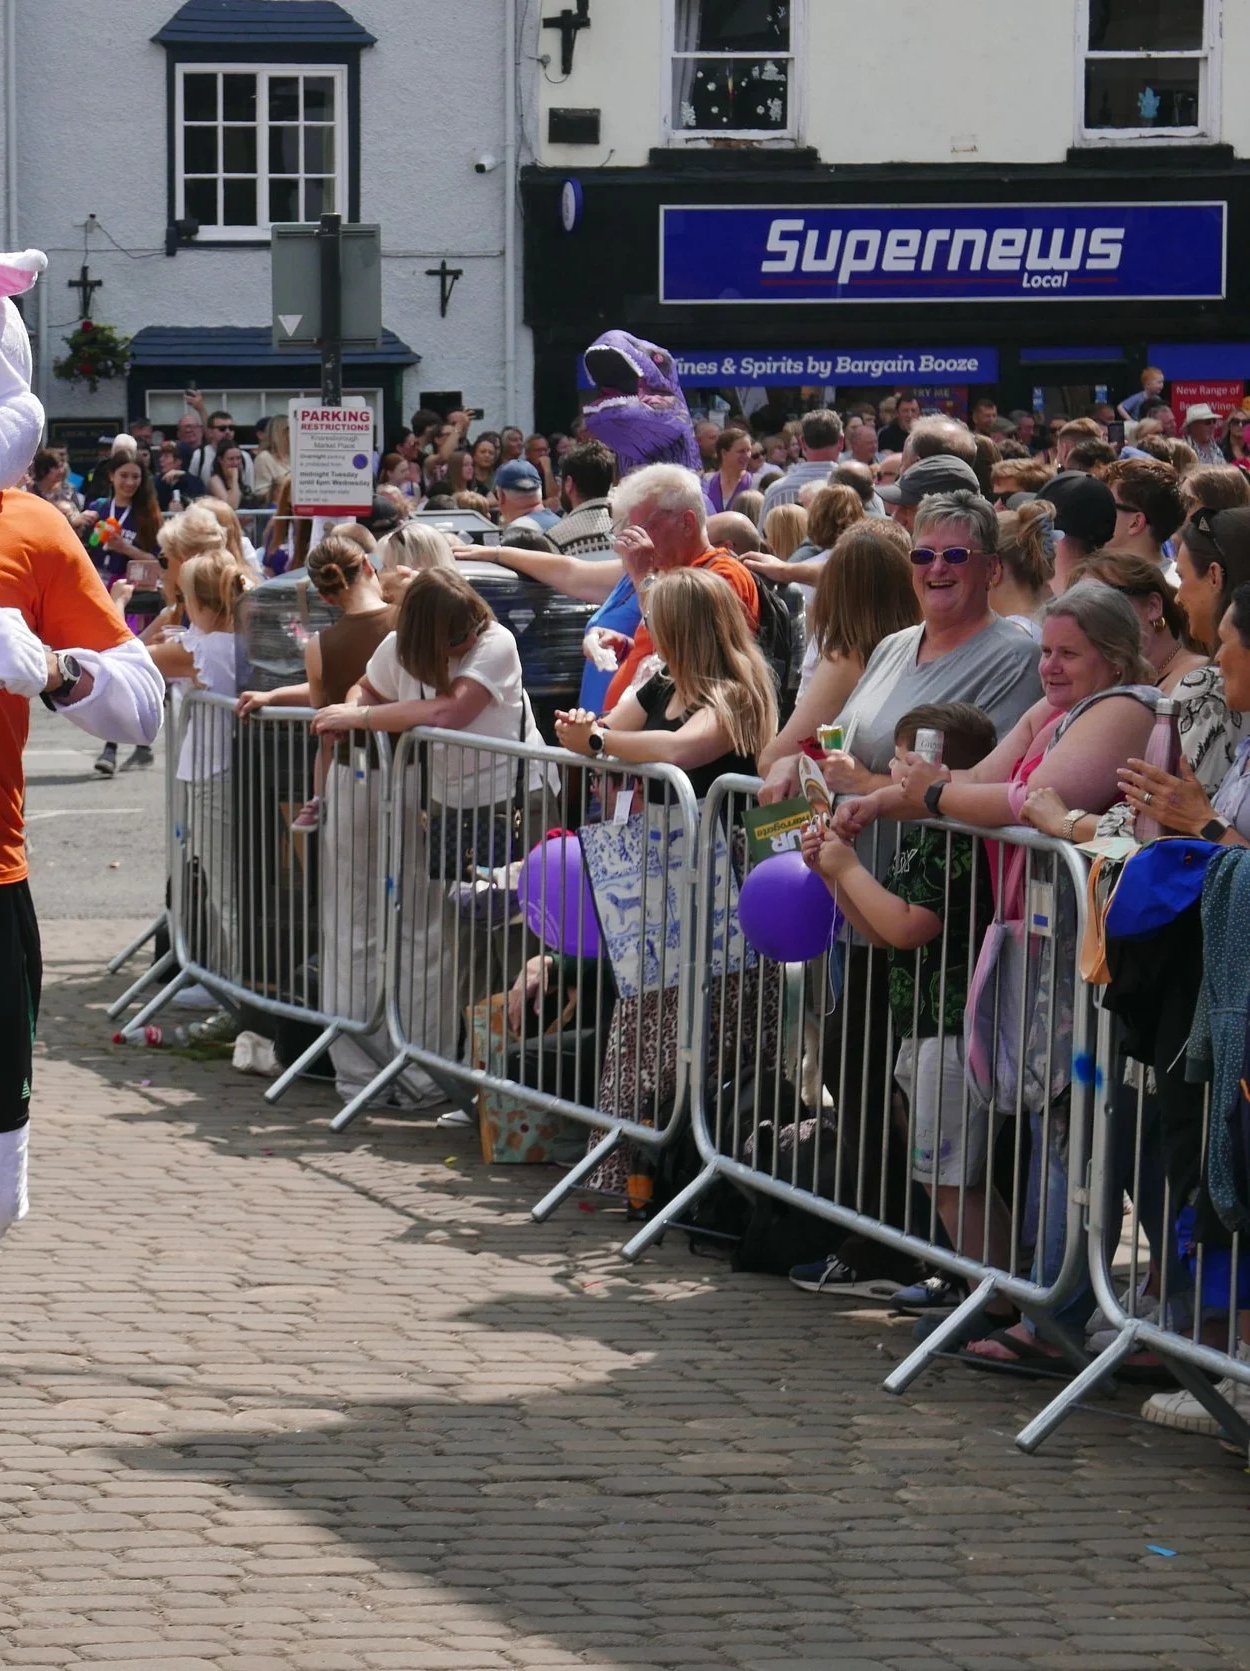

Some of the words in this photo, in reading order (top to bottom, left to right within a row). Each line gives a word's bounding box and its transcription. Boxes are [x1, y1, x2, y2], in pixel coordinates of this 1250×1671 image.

[761, 218, 1125, 284] Supernews
[1022, 271, 1069, 289] Local
[720, 357, 736, 376] &
[740, 357, 804, 379] Spirits
[806, 355, 832, 379] by
[835, 355, 916, 378] Bargain
[918, 355, 979, 373] Booze
[1176, 385, 1197, 395] New
[1199, 385, 1228, 397] Range
[1229, 385, 1240, 395] of
[301, 410, 370, 422] PARKING
[300, 423, 370, 432] RESTRICTIONS
[310, 435, 359, 443] Knaresborough
[331, 471, 358, 479] Tuesday
